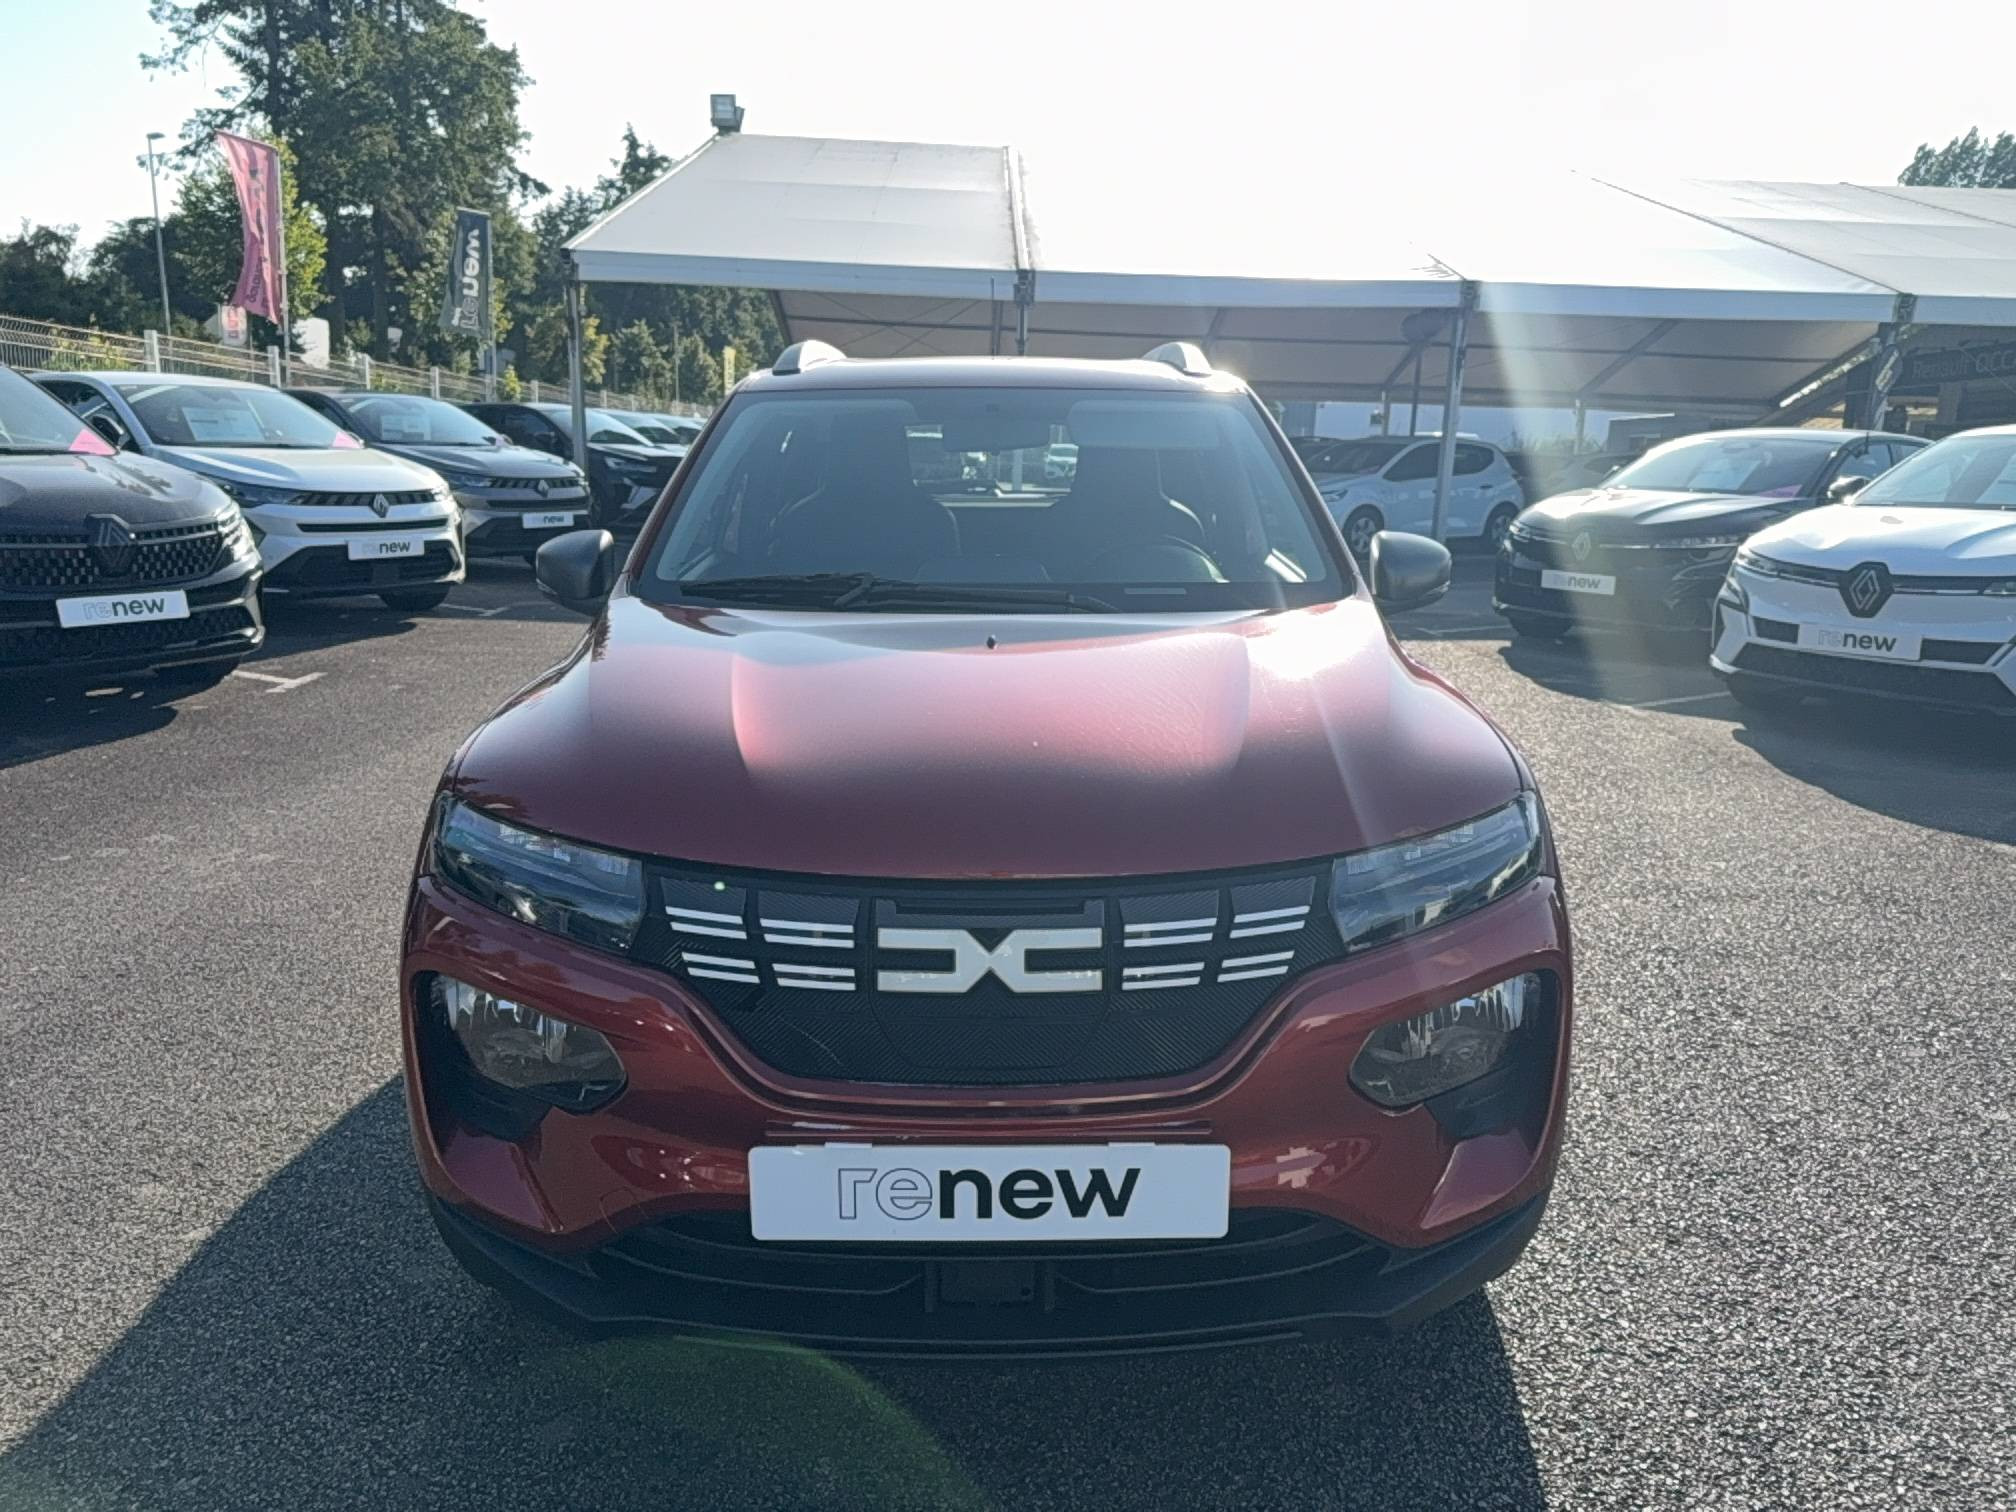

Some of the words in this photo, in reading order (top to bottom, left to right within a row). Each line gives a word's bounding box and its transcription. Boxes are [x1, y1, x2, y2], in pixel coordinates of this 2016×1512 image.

[532, 515, 564, 525] new
[1553, 573, 1601, 589] new
[82, 598, 165, 620] renew
[838, 1167, 1141, 1220] renew
